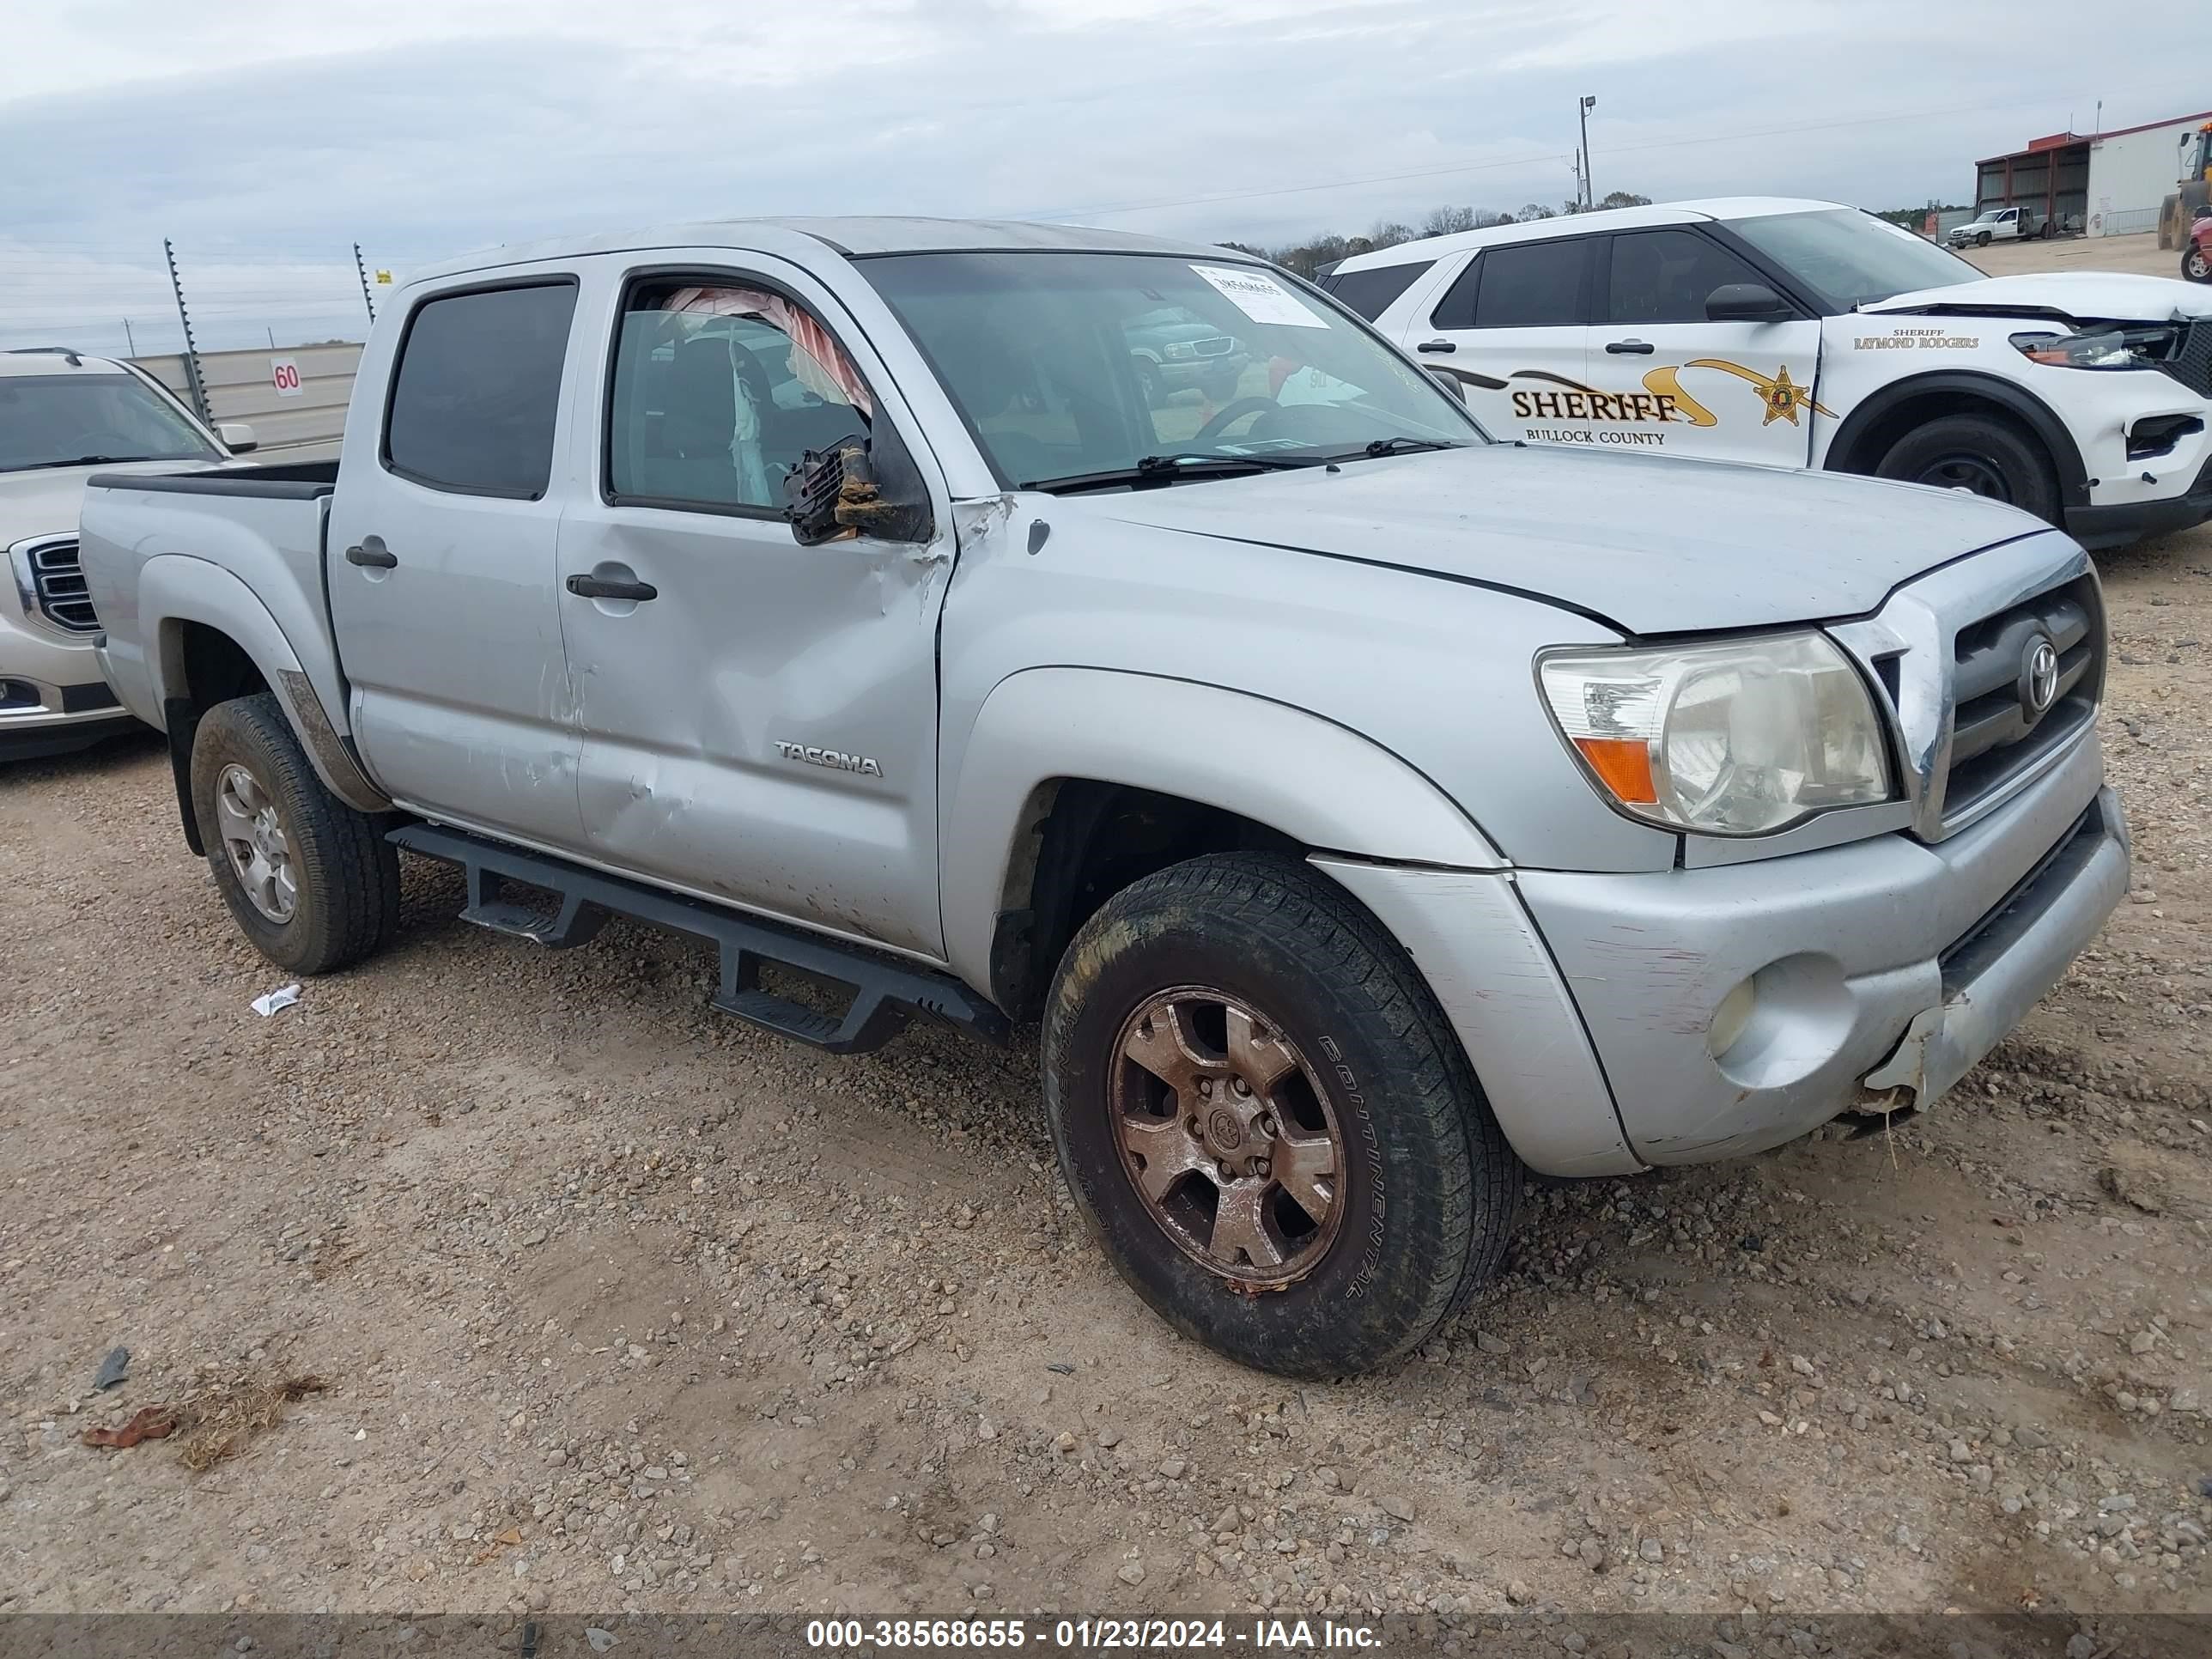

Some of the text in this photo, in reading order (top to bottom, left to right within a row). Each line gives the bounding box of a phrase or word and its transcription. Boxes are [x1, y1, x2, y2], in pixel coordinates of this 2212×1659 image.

[1854, 337, 1979, 350] RAYMOND RODGERS
[275, 365, 299, 389] 60
[1511, 391, 1676, 423] SHERIFF
[1527, 428, 1666, 446] BULLOCK COUNTY
[774, 739, 884, 778] TACOMA
[1318, 1036, 1386, 1298] CONTINENTAL
